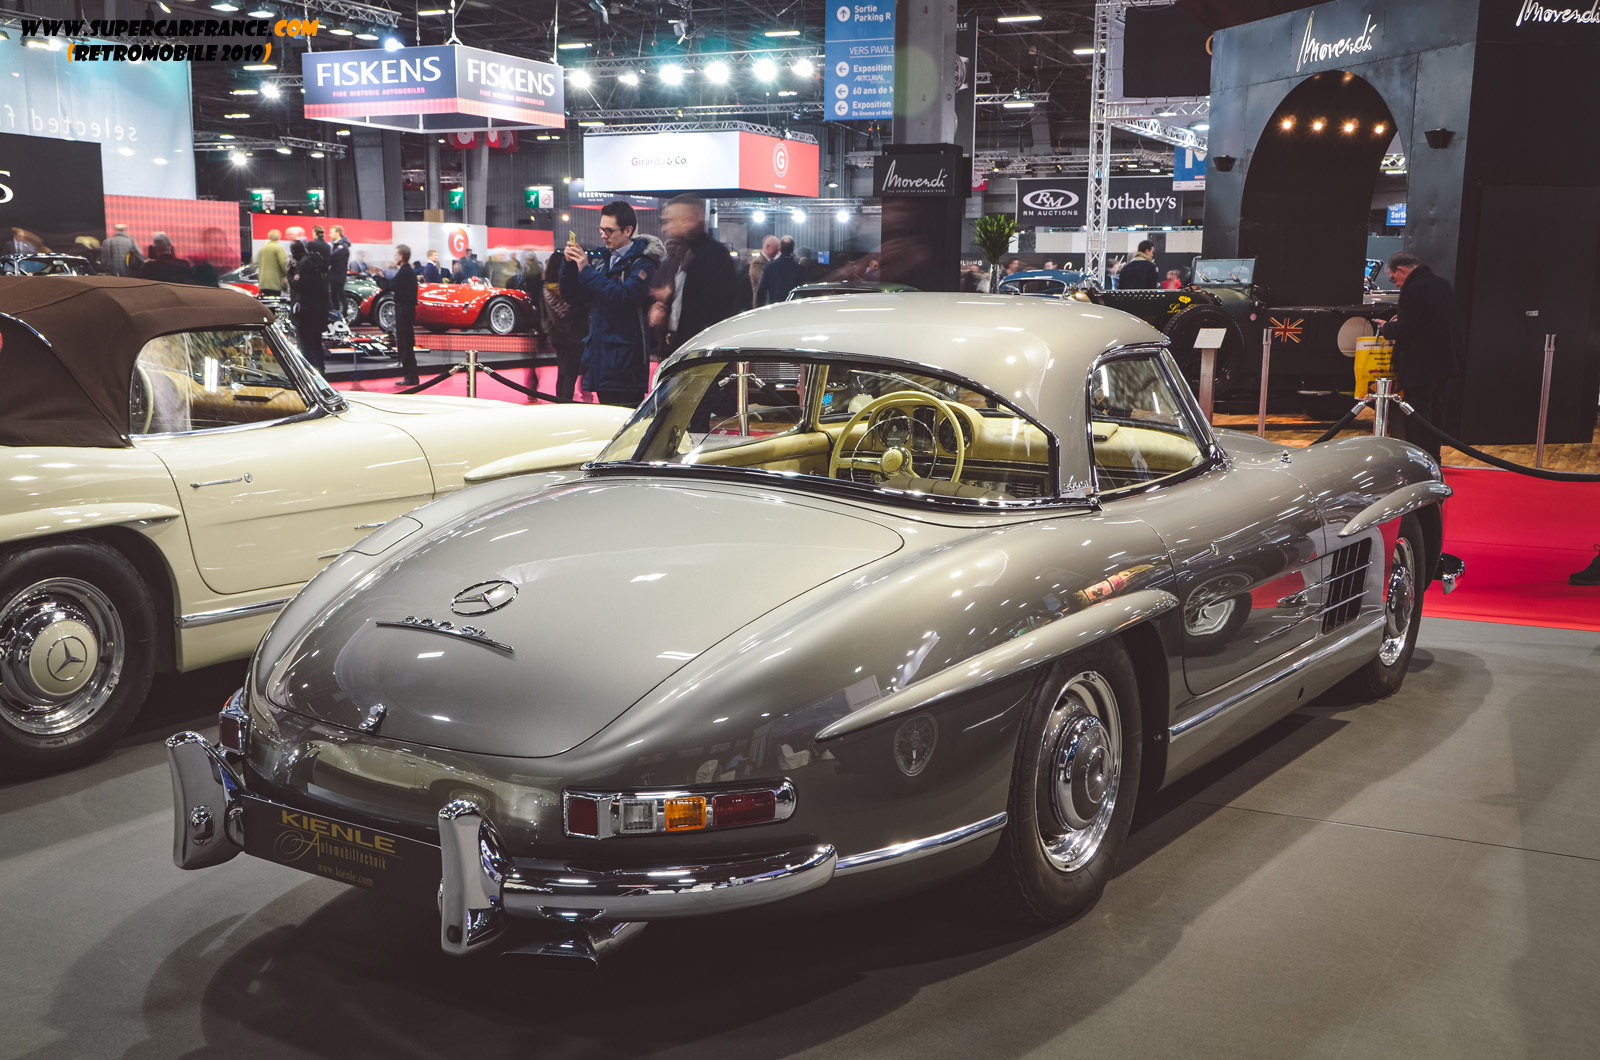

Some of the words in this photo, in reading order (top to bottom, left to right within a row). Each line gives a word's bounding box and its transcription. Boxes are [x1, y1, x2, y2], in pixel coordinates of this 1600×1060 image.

[854, 5, 878, 13] Sortie
[854, 13, 884, 22] Parking
[885, 12, 891, 20] R
[849, 46, 869, 55] VERS
[316, 55, 442, 88] FISKENS
[467, 58, 556, 97] FISKENS
[853, 63, 892, 74] Exposition
[349, 89, 380, 97] HISTORIC
[381, 87, 426, 95] AUTOMOBILES
[852, 87, 862, 95] 60
[878, 86, 888, 94] de
[852, 100, 891, 110] Exposition
[776, 151, 785, 170] G
[1035, 191, 1065, 208] RM
[1097, 192, 1177, 213] otheby's
[453, 233, 465, 253] G
[281, 809, 396, 854] KIENLE
[274, 829, 386, 871] Automobiltechnik
[317, 863, 374, 888] www.kienle.com
